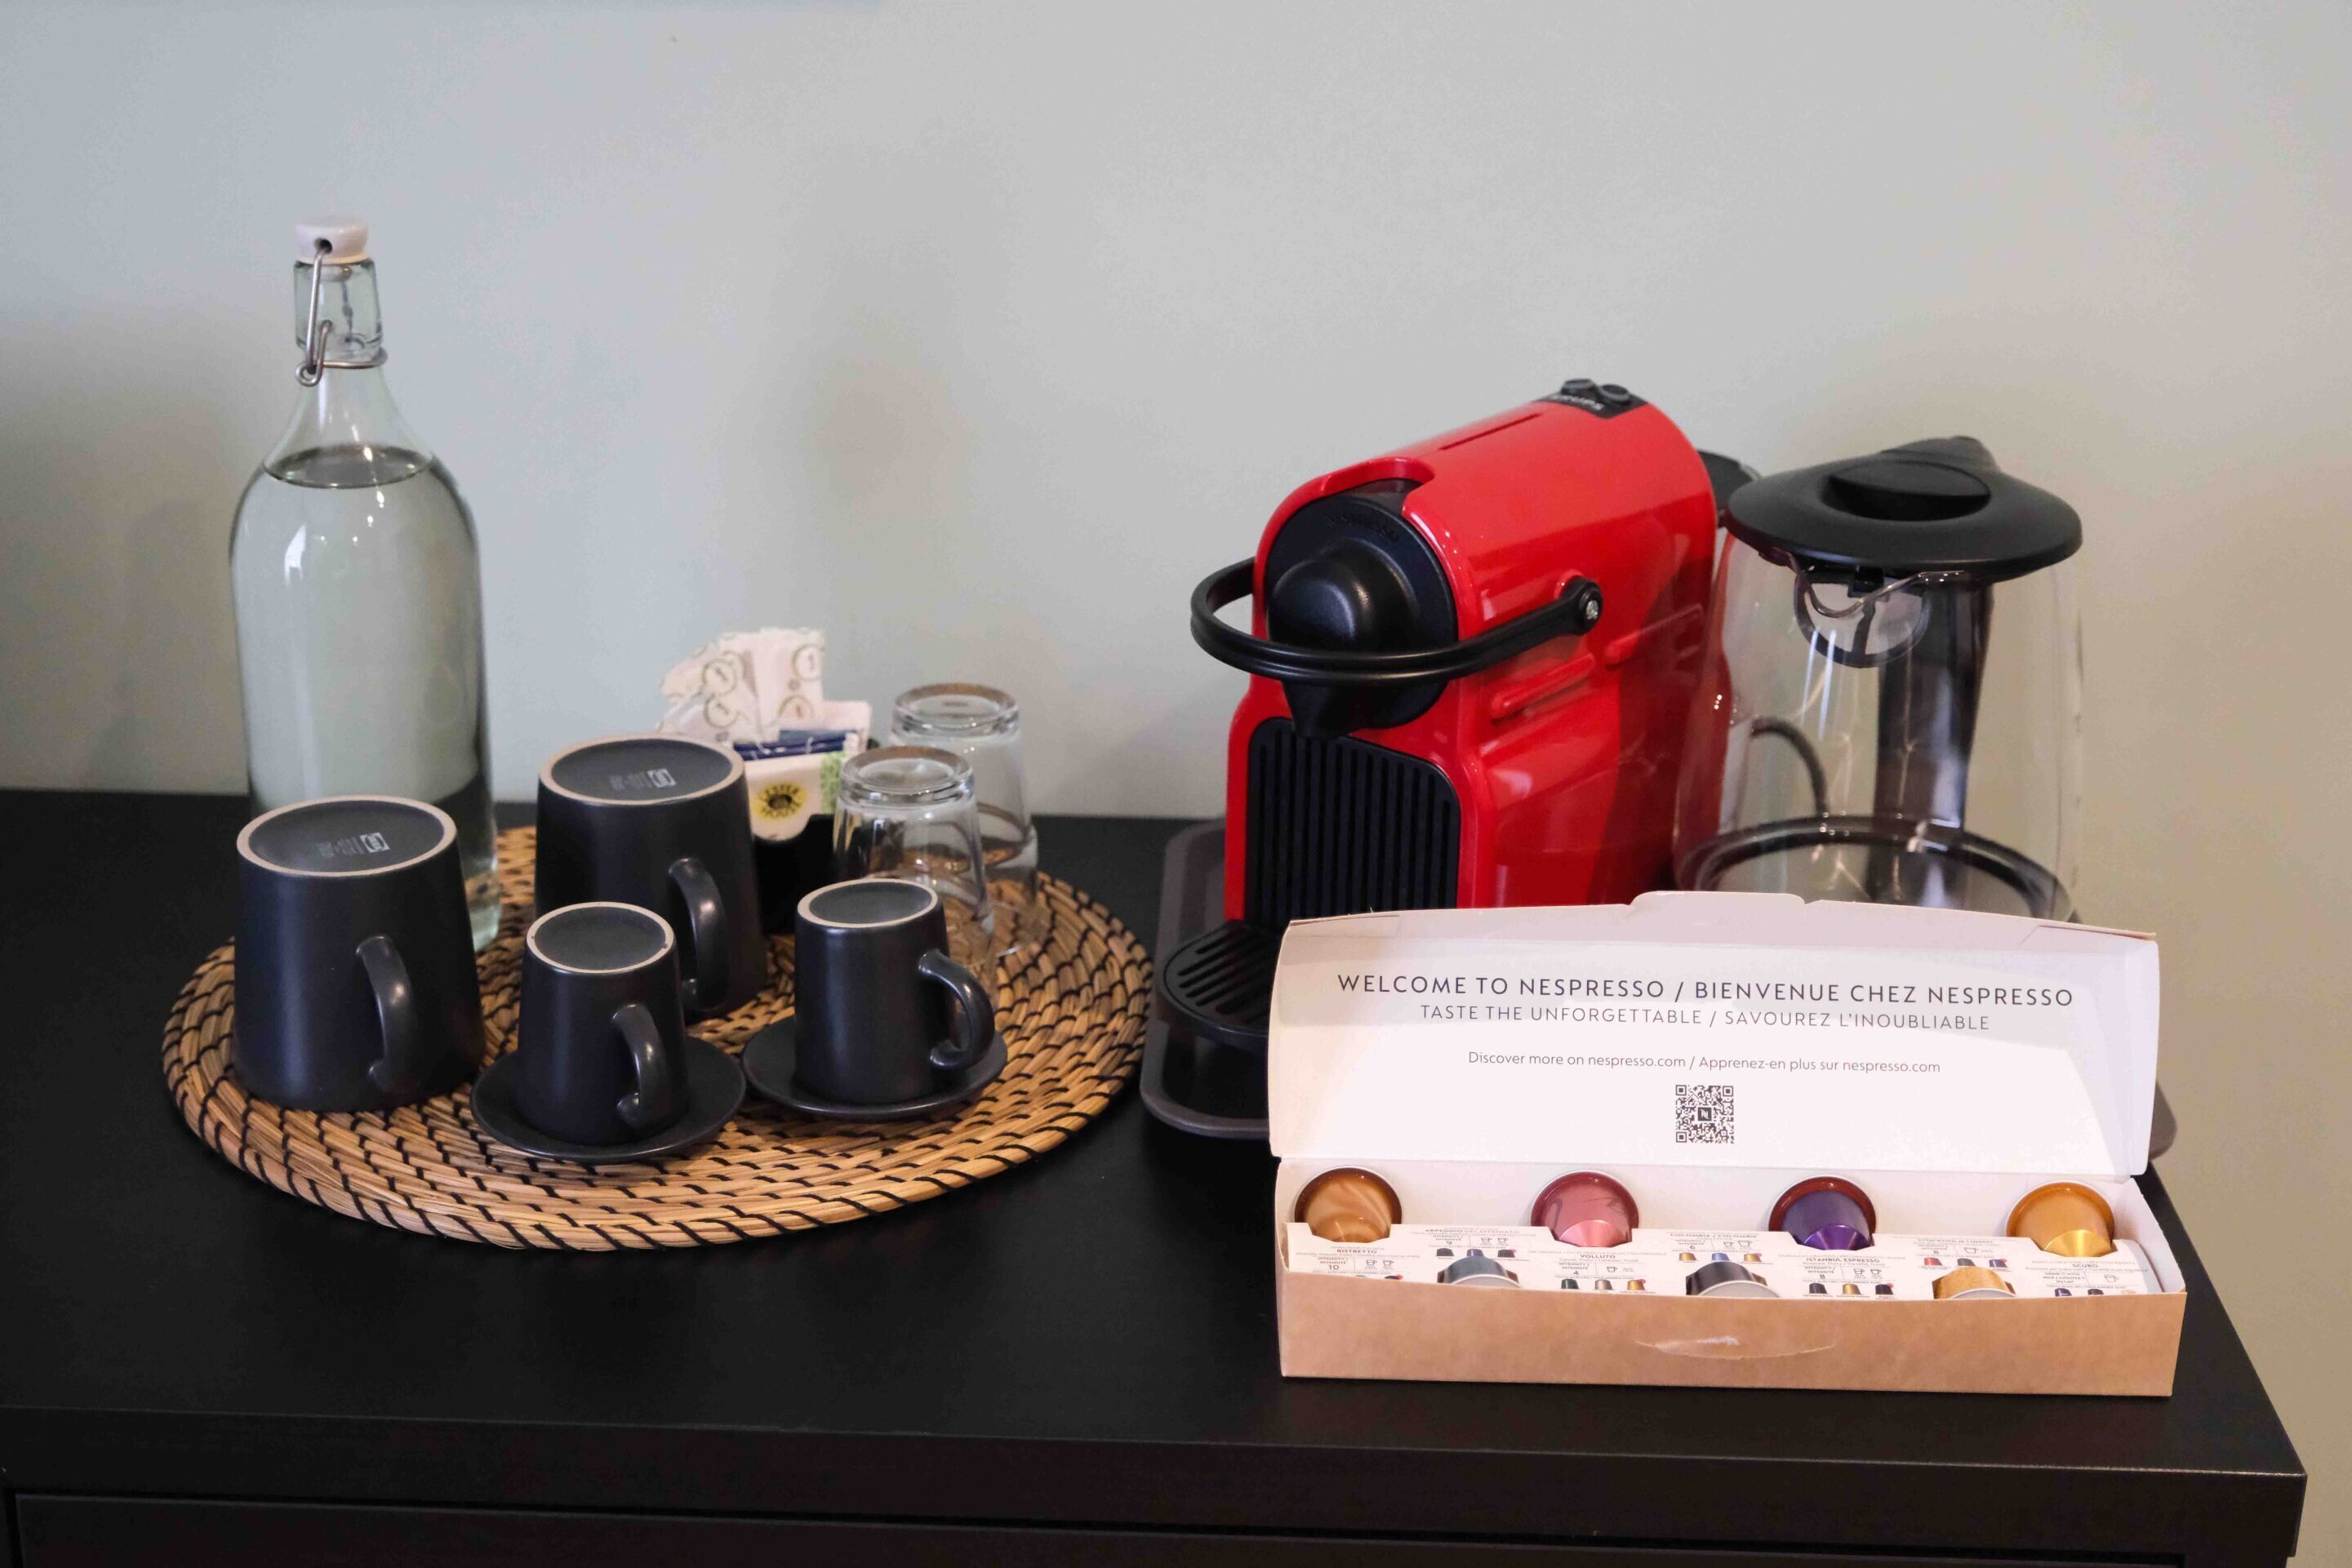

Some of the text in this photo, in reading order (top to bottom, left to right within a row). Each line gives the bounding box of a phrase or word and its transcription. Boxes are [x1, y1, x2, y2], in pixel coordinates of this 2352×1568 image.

[1336, 974, 2073, 1006] WELCOME TO NESPRESSO / BIENVENUE CHEZ NESPRESSO
[1420, 1004, 1990, 1030] TASTE THE UNFORGETTABLE / SAVOUREZ L'INOUBLIABLE
[1469, 1051, 1941, 1074] Discover more on nespresso.com / Apprenez-en plus sur nespresso.com
